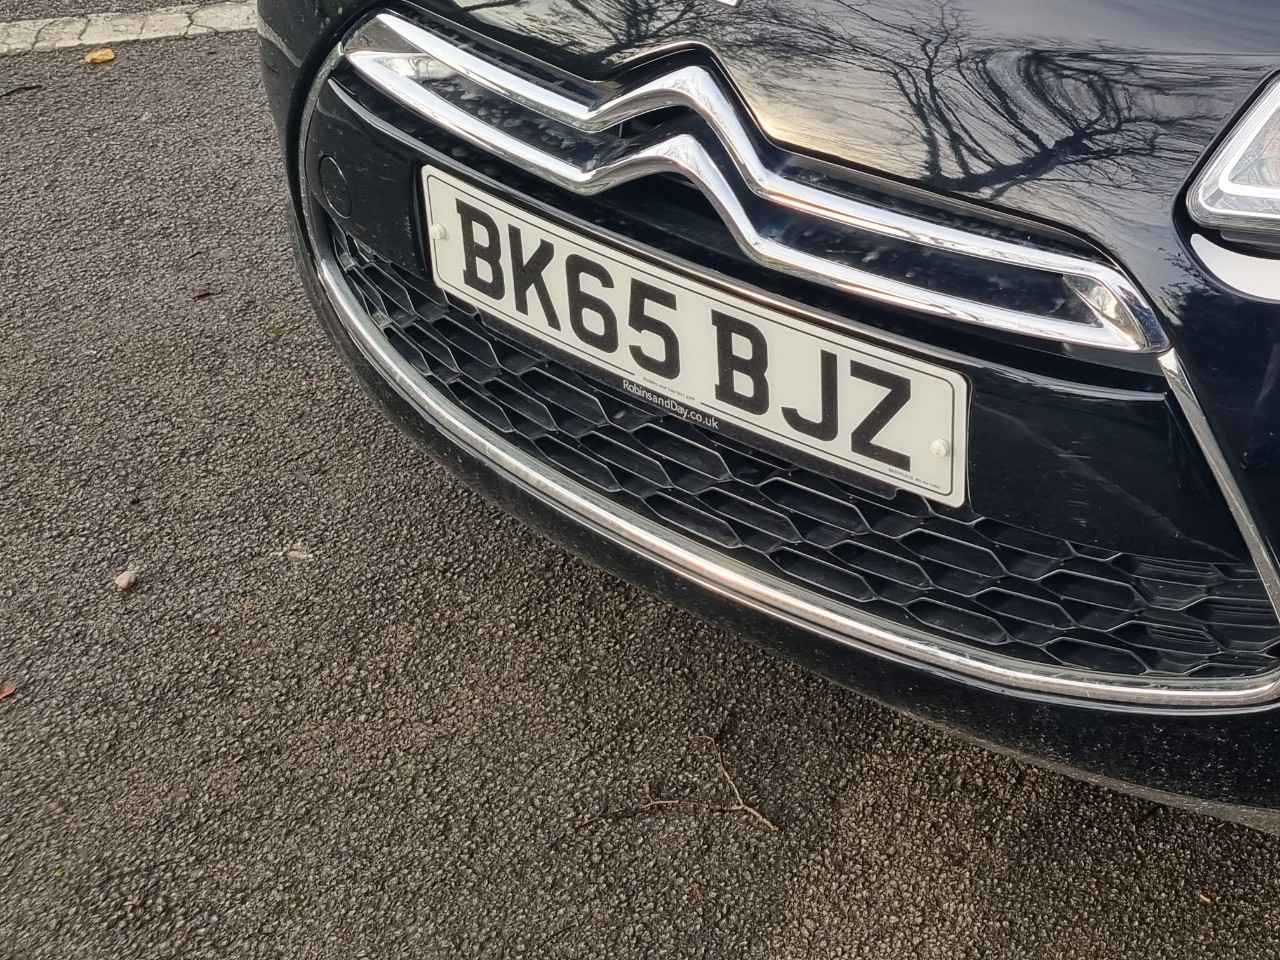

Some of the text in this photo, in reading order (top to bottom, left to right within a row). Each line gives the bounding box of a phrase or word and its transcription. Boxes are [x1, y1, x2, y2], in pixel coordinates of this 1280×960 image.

[454, 197, 911, 472] BK65 BJZ
[622, 379, 719, 430] RobinsandDay.co.uk
